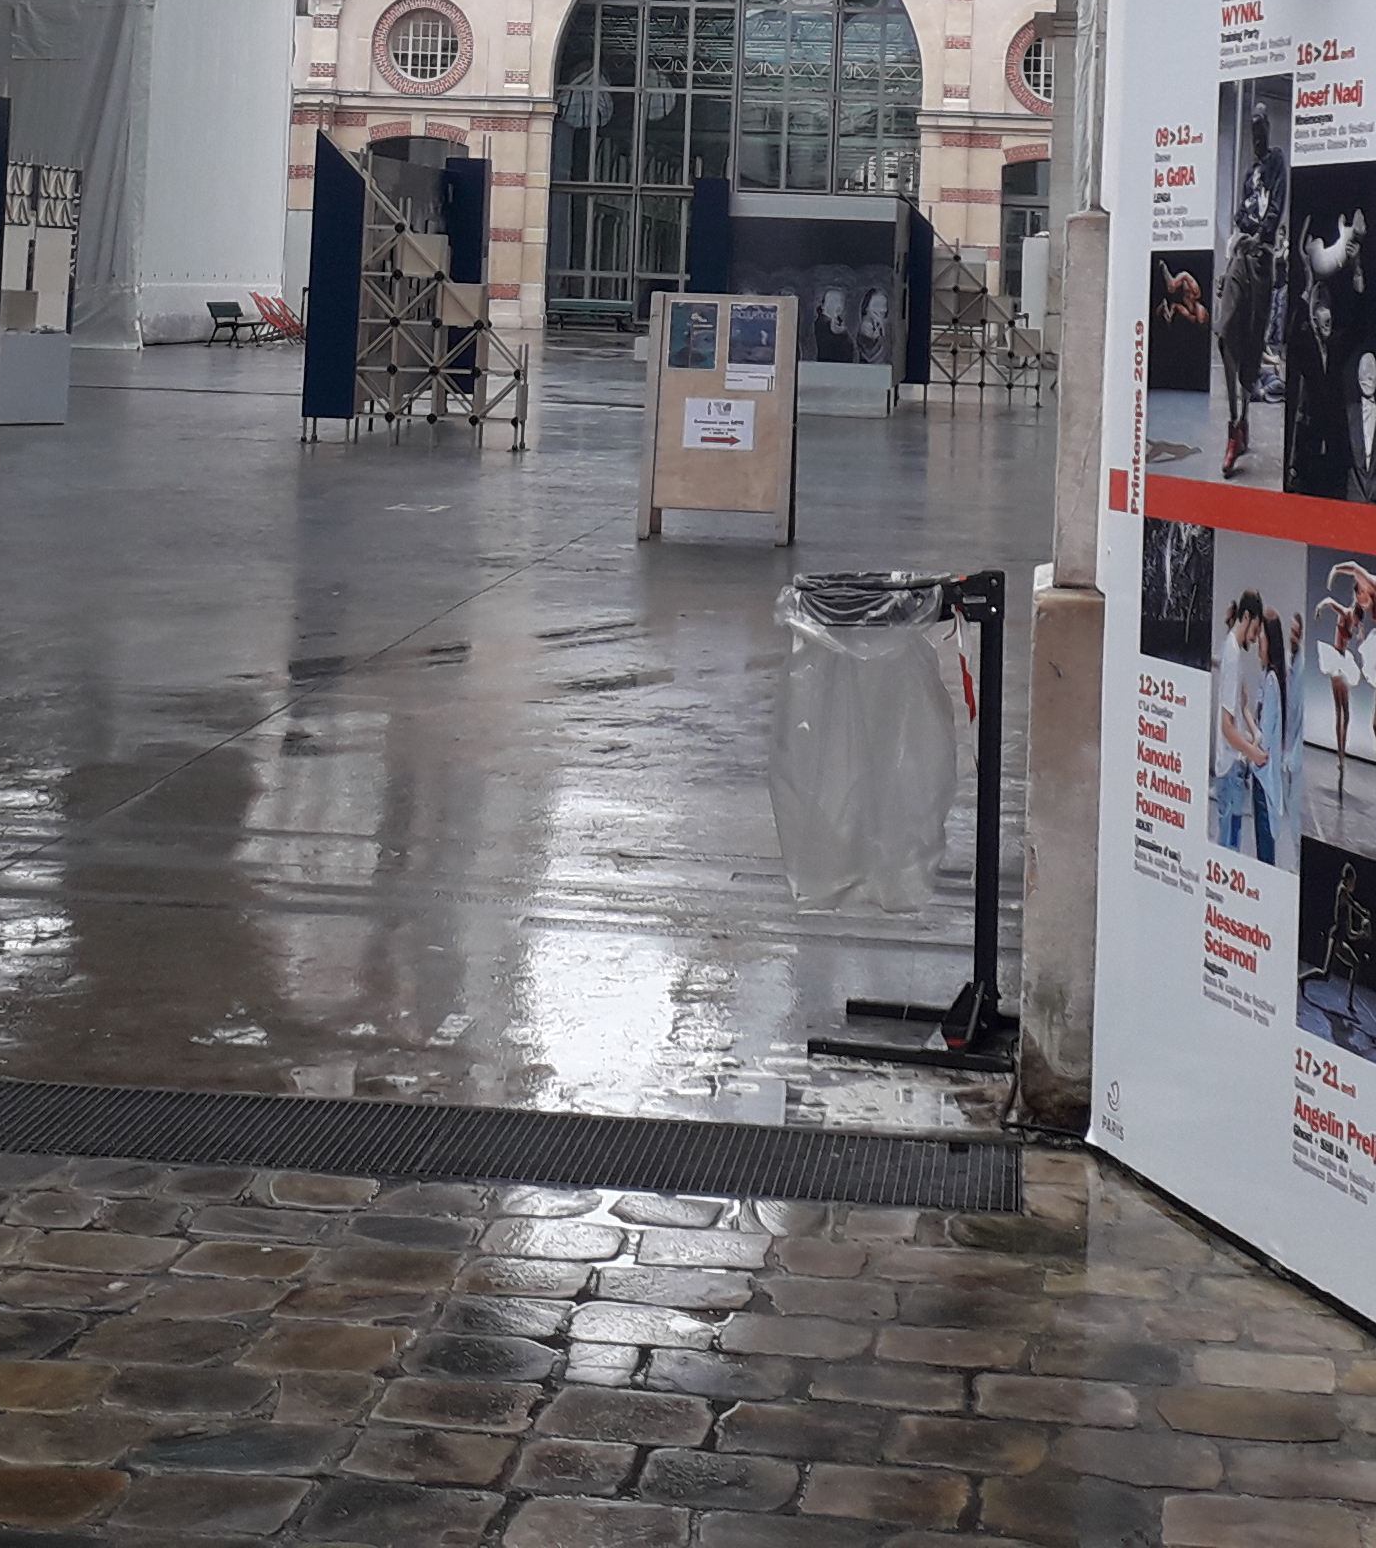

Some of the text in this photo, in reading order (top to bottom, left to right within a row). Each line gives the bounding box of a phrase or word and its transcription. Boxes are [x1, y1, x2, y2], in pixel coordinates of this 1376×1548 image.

[1222, 0, 1264, 26] WYNKL
[1295, 80, 1363, 108] Josef Nadj
[1155, 168, 1164, 188] le
[1131, 321, 1144, 514] Printemps 2019
[1137, 739, 1182, 774] Kanouté
[1137, 768, 1191, 804] et Antonin
[1205, 904, 1271, 950] Alessandro
[1204, 930, 1256, 973] Sciarroni
[1294, 1096, 1344, 1140] Angelin
